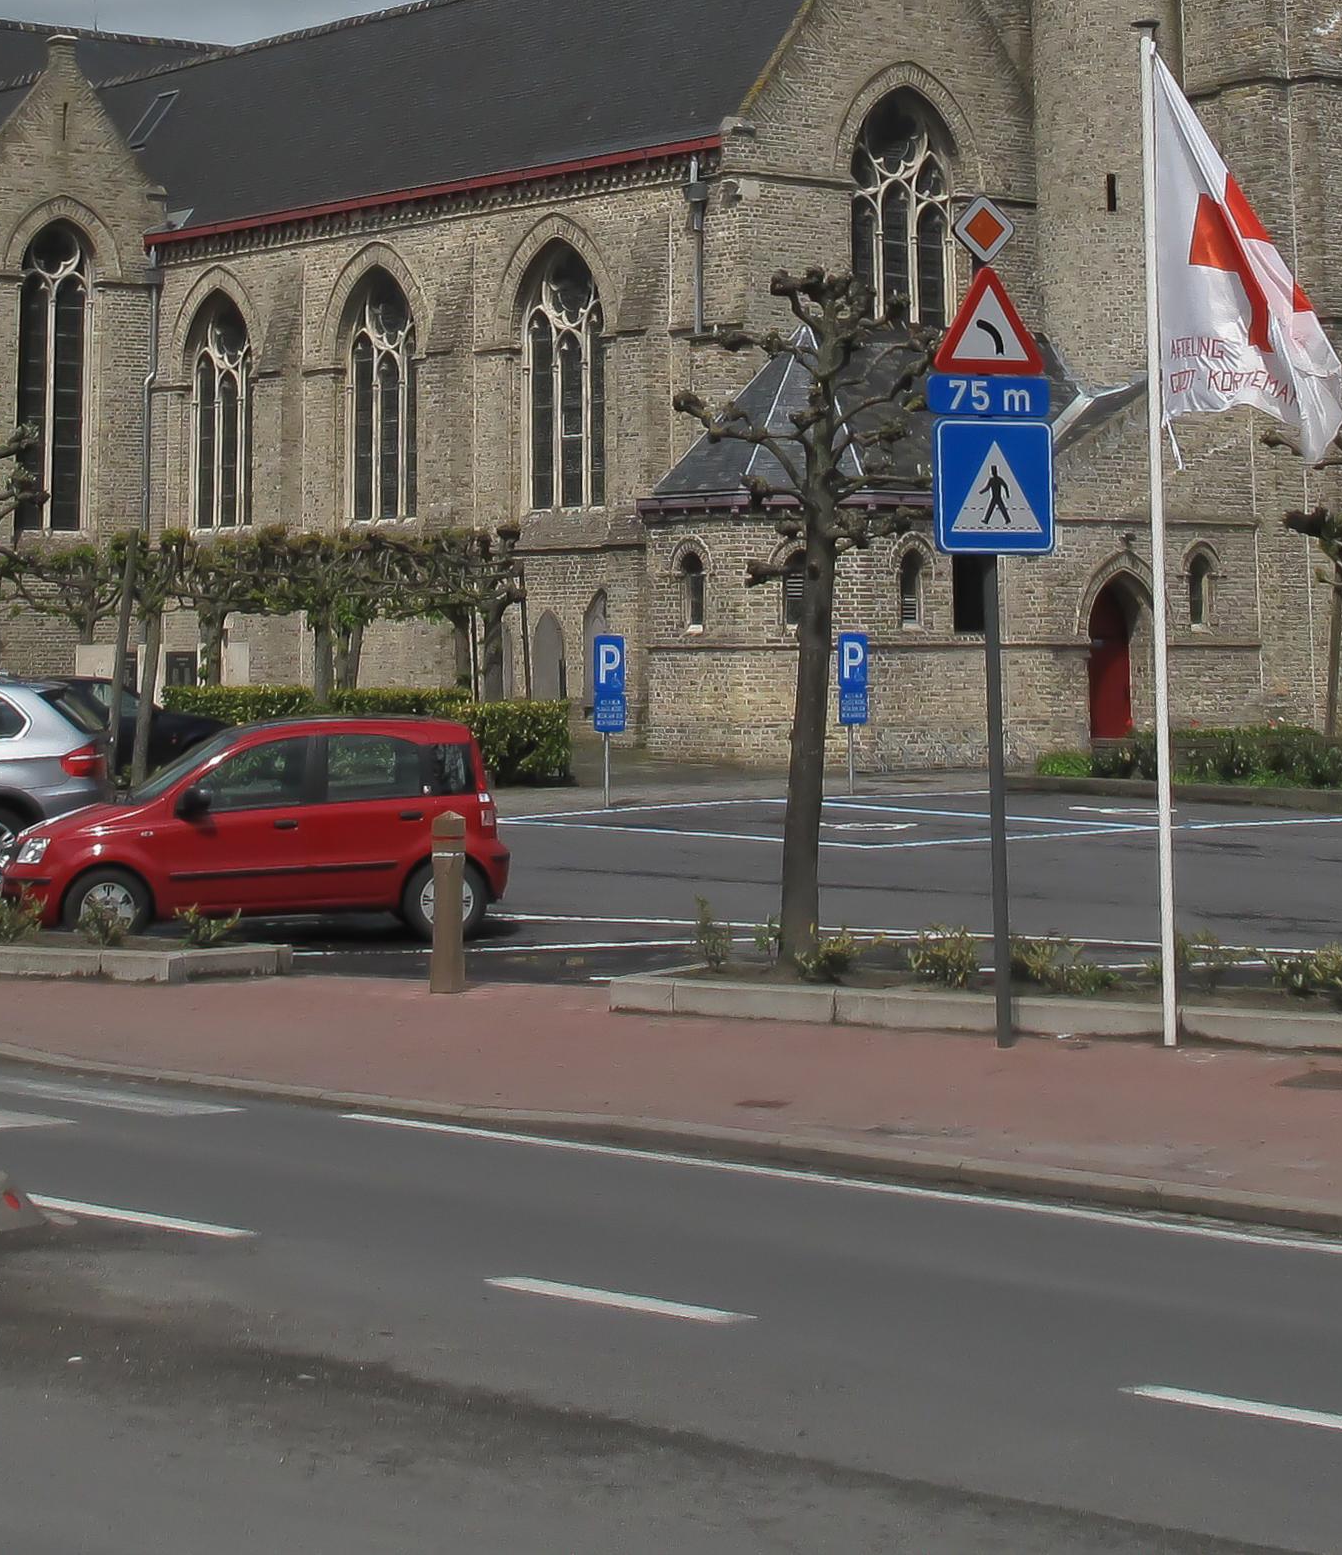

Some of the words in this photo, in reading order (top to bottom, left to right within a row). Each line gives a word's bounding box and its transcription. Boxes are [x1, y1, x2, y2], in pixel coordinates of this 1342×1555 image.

[948, 380, 990, 411] 75
[1003, 389, 1030, 412] m
[599, 644, 621, 684] P
[843, 641, 864, 679] P
